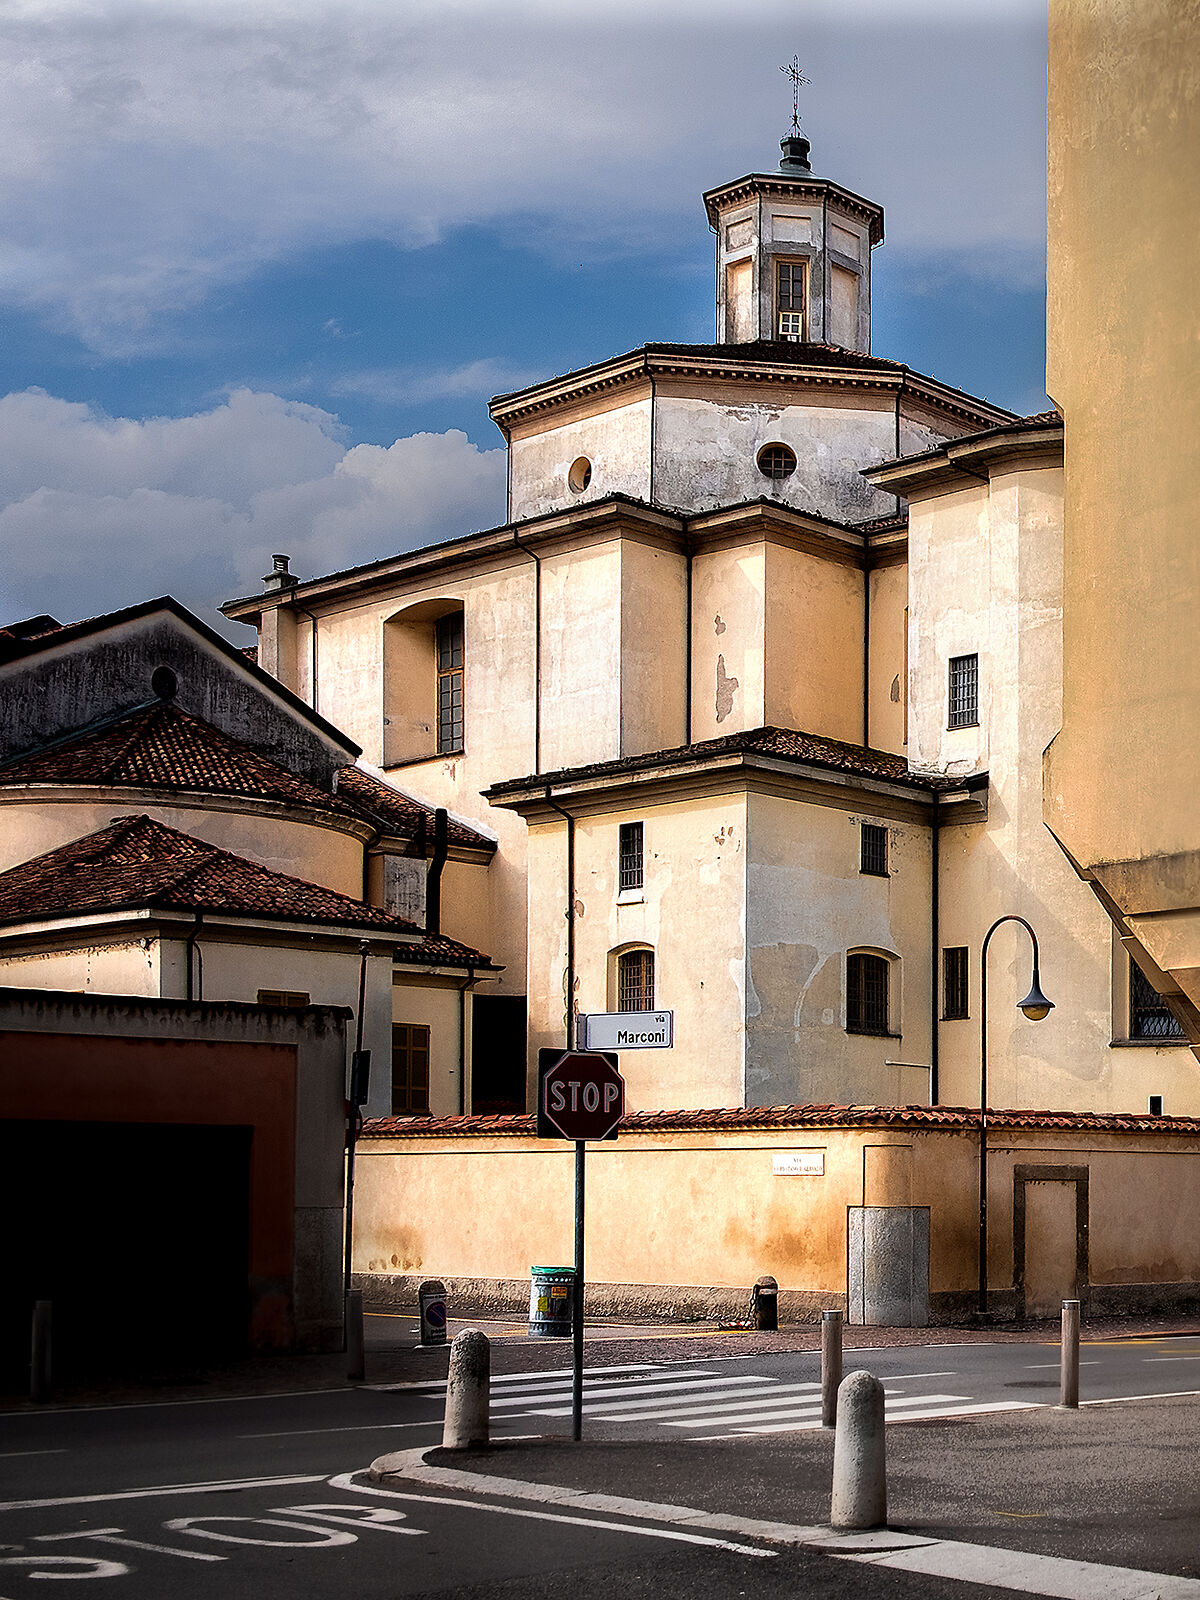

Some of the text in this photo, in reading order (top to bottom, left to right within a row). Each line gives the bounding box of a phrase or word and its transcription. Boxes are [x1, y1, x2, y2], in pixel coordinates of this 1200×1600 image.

[654, 1015, 666, 1023] via
[618, 1029, 666, 1044] Marconi
[550, 1081, 619, 1113] STOP
